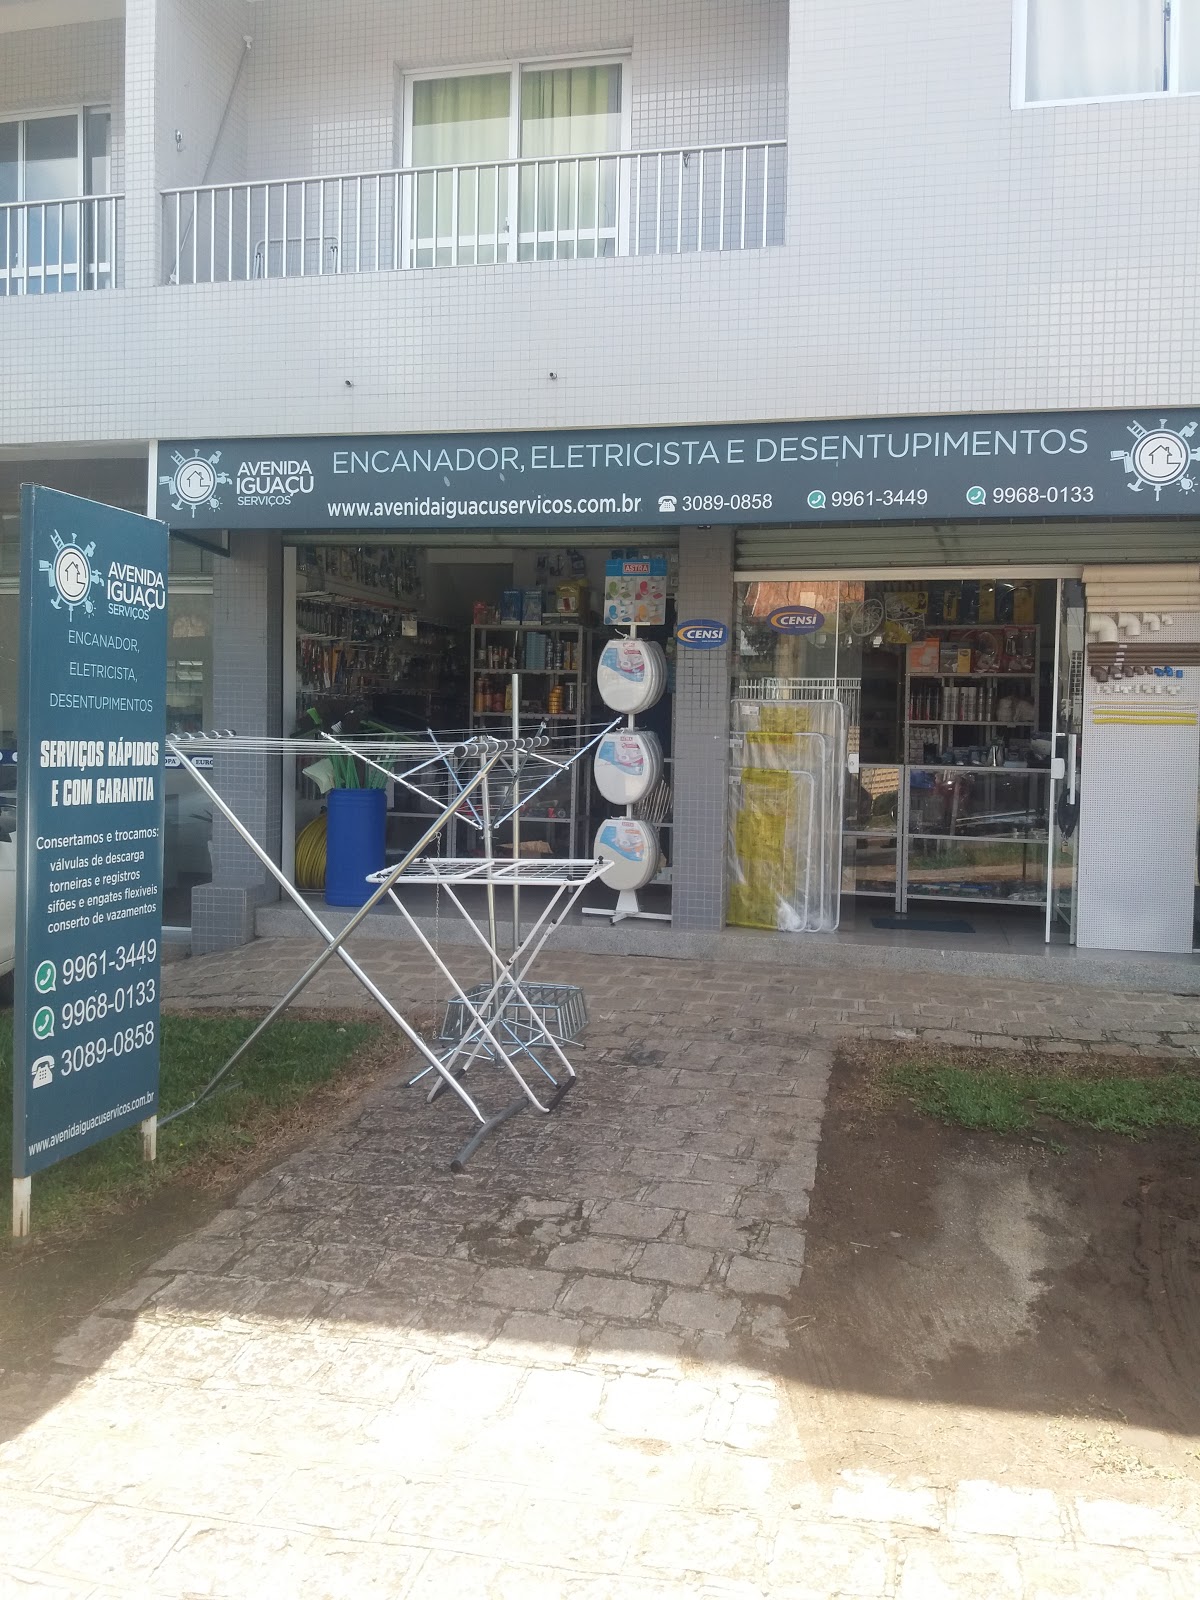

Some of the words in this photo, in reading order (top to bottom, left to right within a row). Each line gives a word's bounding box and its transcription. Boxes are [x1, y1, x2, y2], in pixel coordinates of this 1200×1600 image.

[333, 446, 526, 475] ENCANADOR,
[530, 440, 719, 470] ELETRICISTA
[727, 439, 745, 464] E
[755, 428, 1089, 463] DESENTUPIMENTOS
[236, 460, 312, 477] AVENIDA
[236, 476, 315, 496] IGUAÇU
[992, 485, 1094, 505] 9968-0133
[237, 495, 292, 508] SERVIÇOS
[327, 494, 642, 519] www.avenidaiguacuservicos.com.br
[682, 493, 773, 512] 3089-0858
[831, 488, 928, 508] 9961-3449
[107, 561, 165, 589] AVENIDA
[625, 564, 649, 572] ASTRA
[106, 580, 166, 612] IGUAÇU
[108, 603, 150, 621] SERVIÇOS
[68, 629, 140, 653] ENCANADOR,
[69, 661, 138, 683] ELETRICISTA,
[49, 692, 154, 713] DESENTUPIMENTOS
[40, 740, 104, 771] SERVIÇOS
[108, 736, 159, 767] RÁPIDOS
[51, 780, 59, 807] E
[63, 778, 93, 805] COM
[96, 776, 154, 803] GARANTIA
[36, 832, 104, 850] Consertamos
[106, 832, 113, 842] e
[114, 827, 160, 842] trocamos:
[50, 855, 89, 872] válvulas
[91, 853, 104, 867] de
[105, 849, 145, 866] descarga
[49, 875, 92, 893] torneiras
[94, 876, 101, 886] e
[102, 869, 141, 887] registros
[47, 894, 76, 914] sifões
[78, 898, 85, 908] e
[87, 891, 123, 910] engates
[47, 916, 90, 934] conserto
[92, 911, 104, 925] de
[106, 902, 157, 922] vazamentos
[62, 938, 158, 986] 9961-3449
[61, 978, 156, 1031] 9968-0133
[60, 1020, 155, 1078] 3089-0858
[28, 1091, 155, 1157] www.avenidaiguacuservicos.com.br
